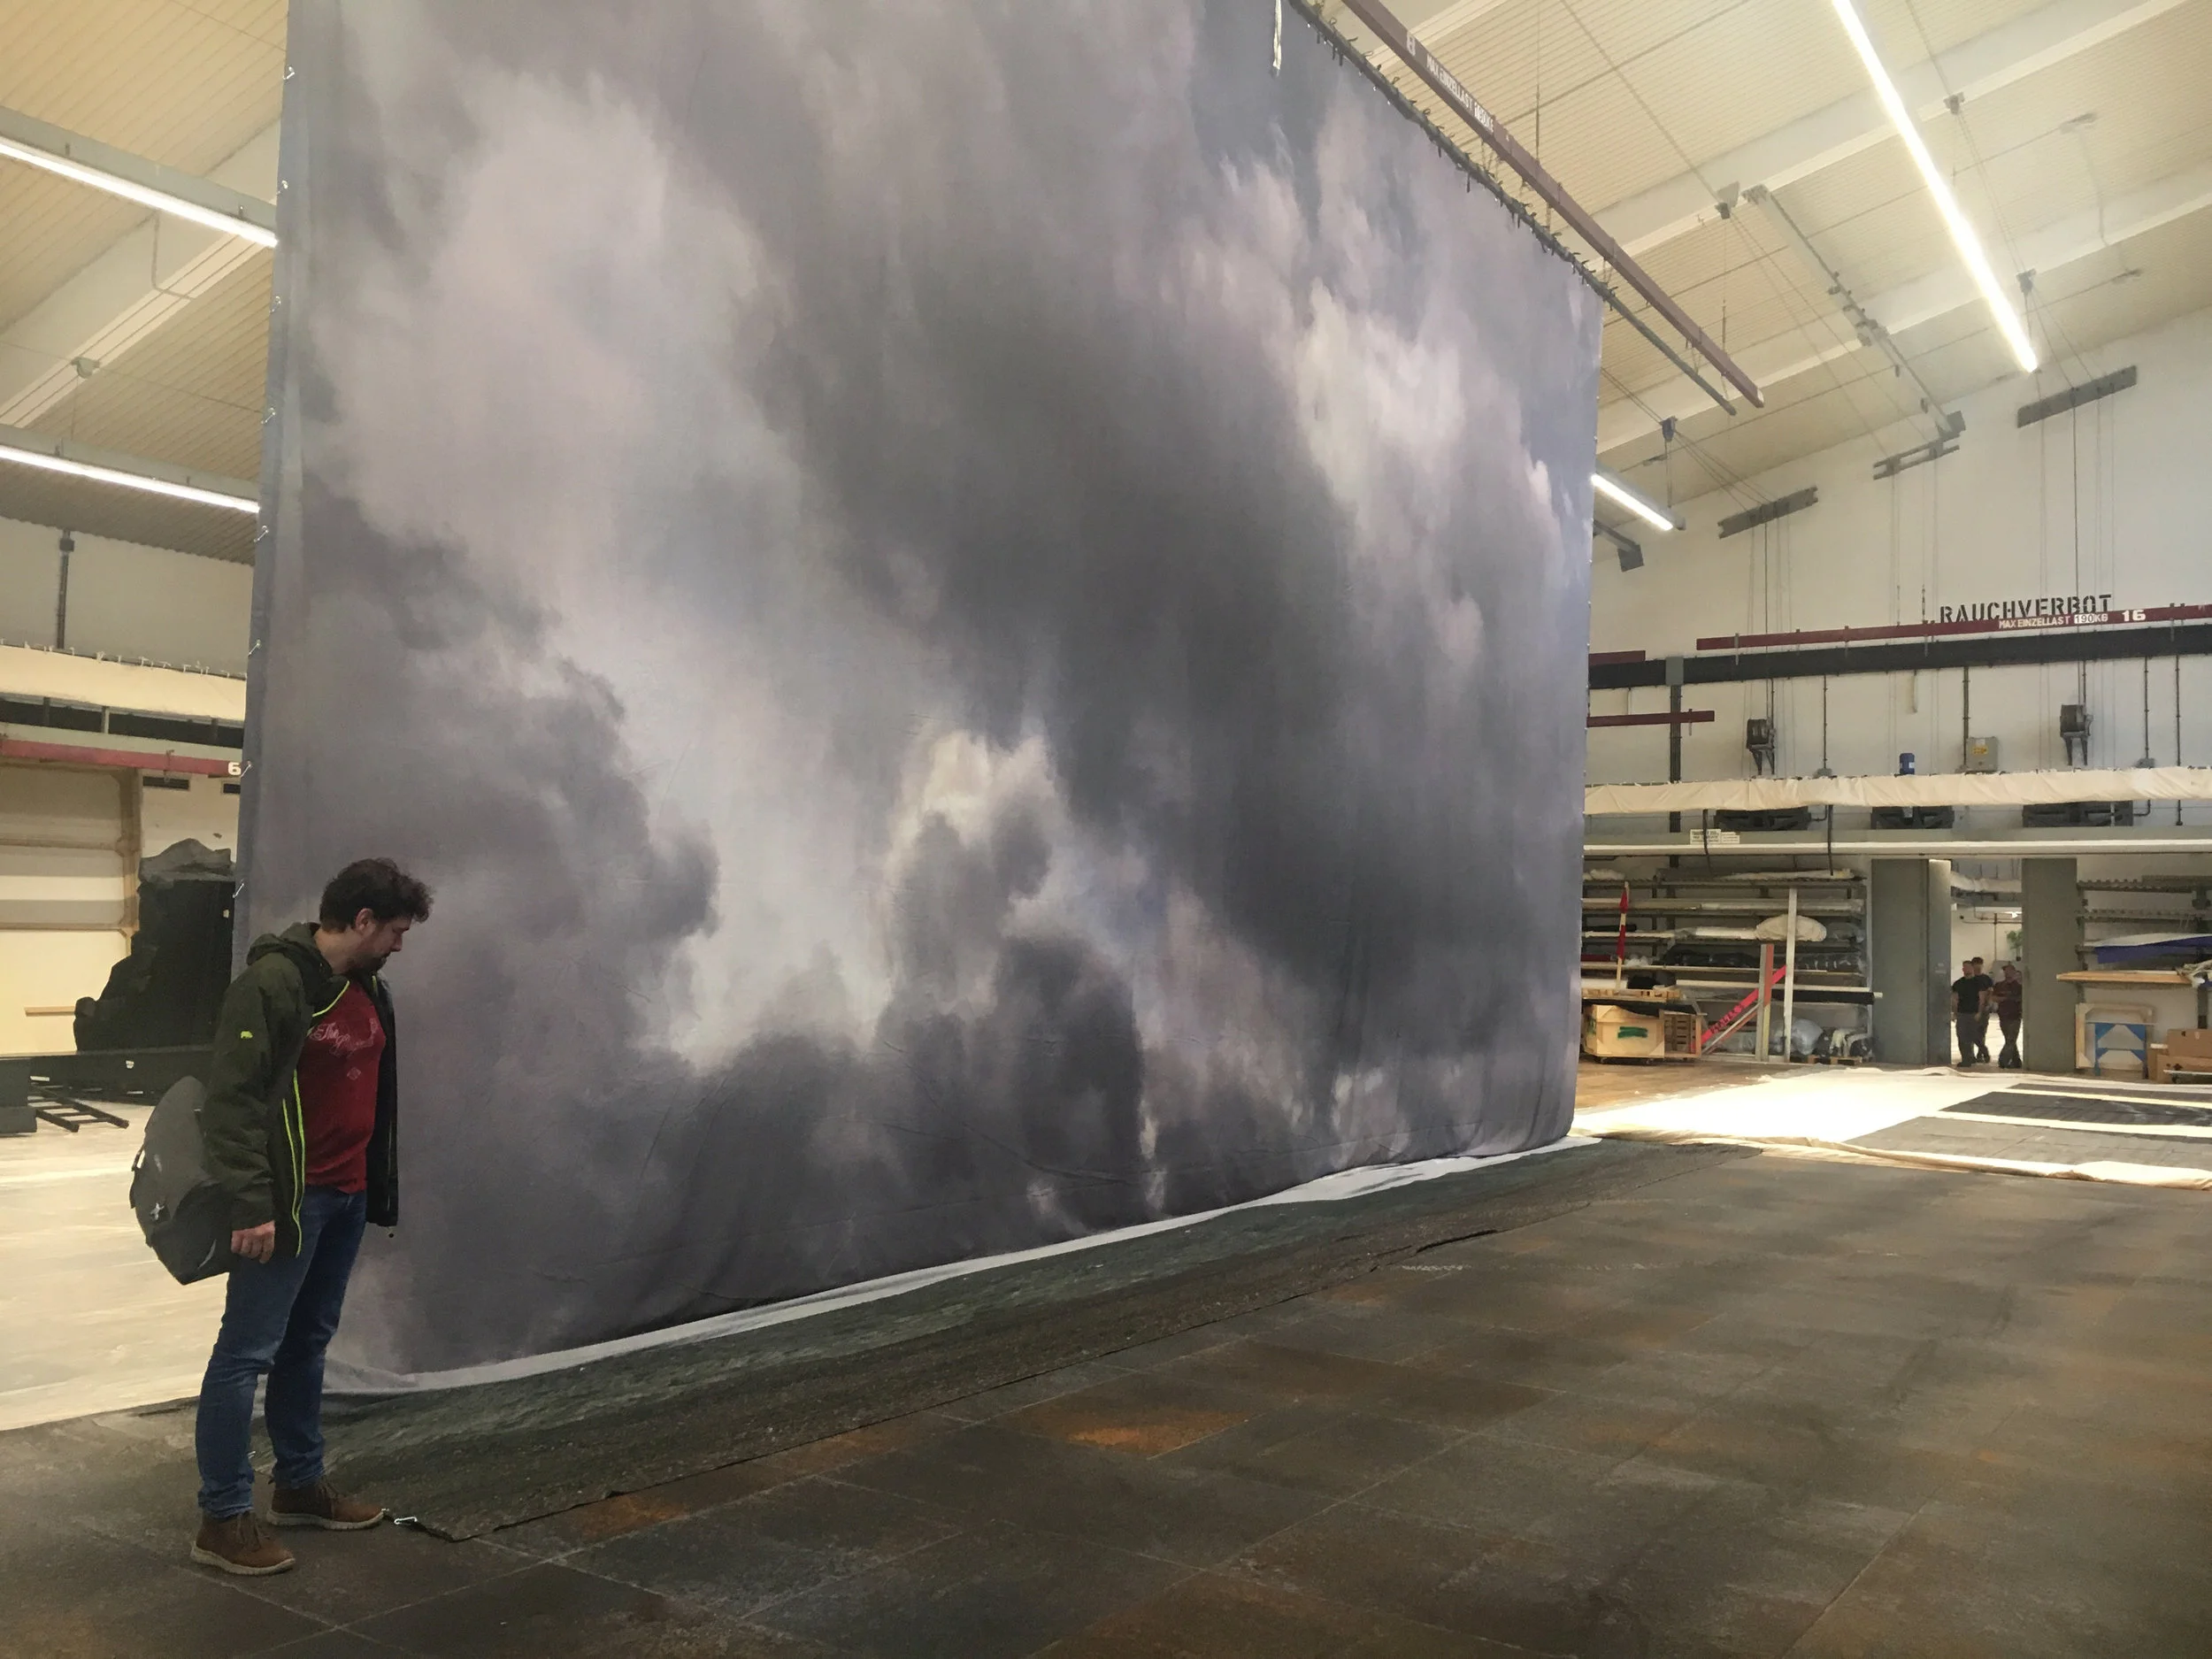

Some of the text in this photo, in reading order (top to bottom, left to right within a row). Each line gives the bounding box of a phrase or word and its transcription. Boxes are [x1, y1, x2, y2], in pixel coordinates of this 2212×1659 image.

[1939, 594, 2112, 624] RAUCHVERBOT
[2122, 609, 2147, 622] 16
[1999, 620, 2016, 629] MAX
[2017, 615, 2070, 628] EINZELLAST
[227, 761, 242, 776] 6
